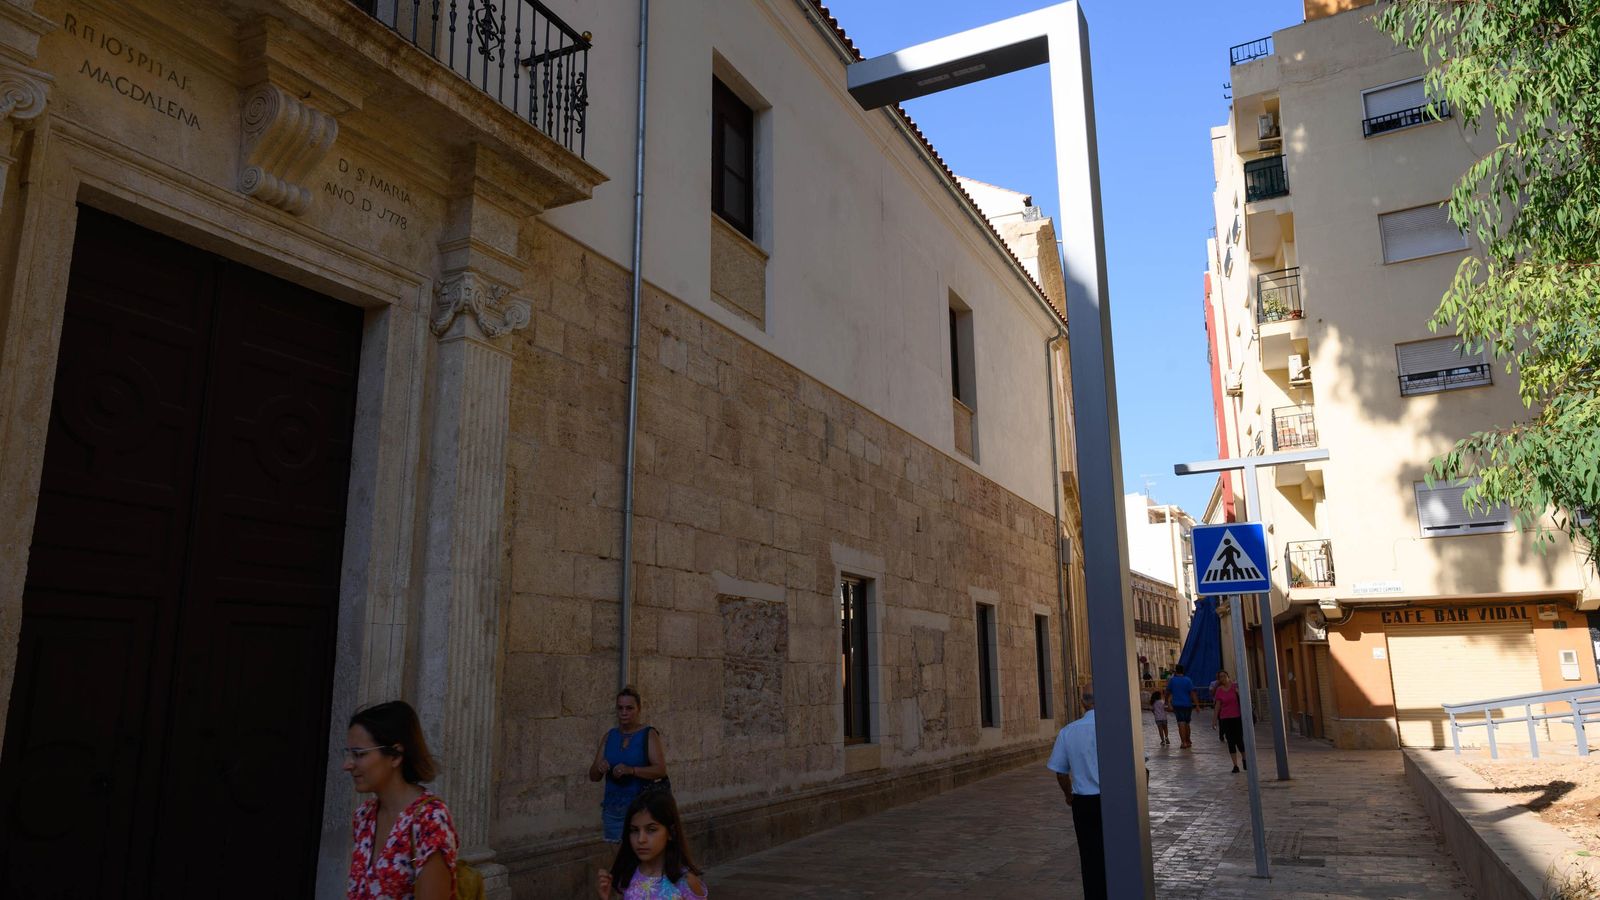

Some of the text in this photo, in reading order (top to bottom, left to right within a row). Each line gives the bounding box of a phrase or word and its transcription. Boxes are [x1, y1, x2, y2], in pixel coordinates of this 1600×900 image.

[369, 175, 411, 206] MARIA
[1434, 607, 1469, 622] BAR
[1476, 605, 1533, 621] VIDAL
